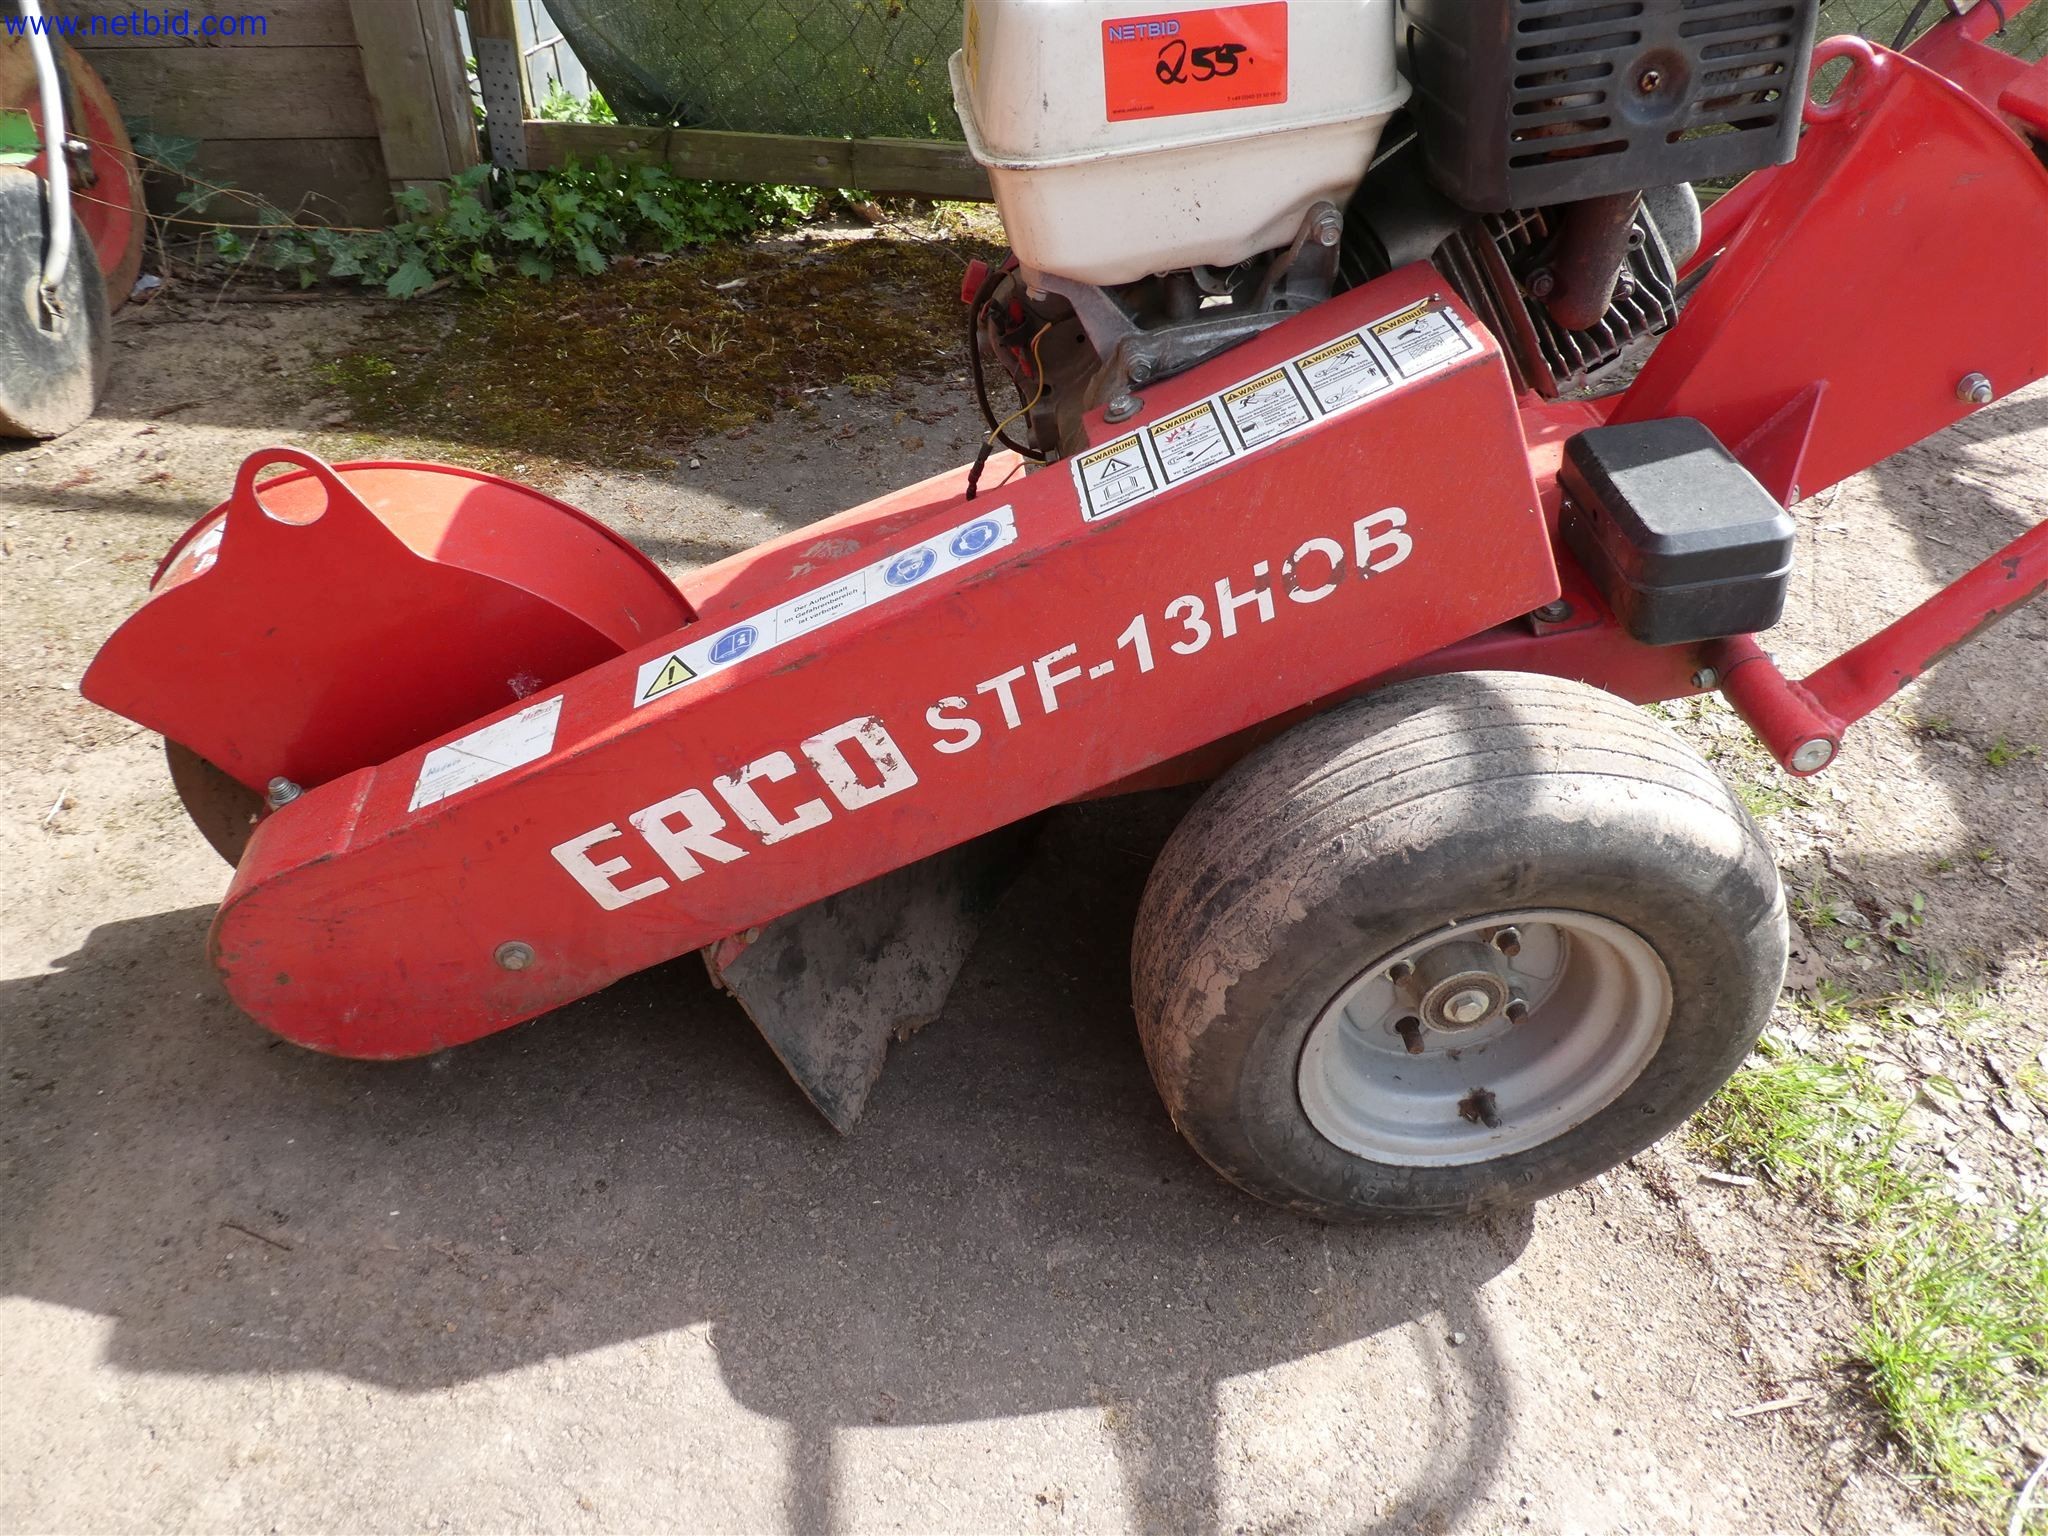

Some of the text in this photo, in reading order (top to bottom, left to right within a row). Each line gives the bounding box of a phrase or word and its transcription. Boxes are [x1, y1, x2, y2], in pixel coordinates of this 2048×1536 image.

[1109, 19, 1180, 41] NETBID
[1312, 338, 1359, 362] WARNUNG
[1237, 372, 1283, 396] WARNUNG
[1165, 406, 1210, 429] WARNUNG
[1094, 438, 1137, 461] WARNUNG
[784, 588, 858, 624] im Gefahrenbereich
[794, 585, 848, 613] Der Aufenthalt
[798, 602, 844, 625] ist verboten
[550, 505, 1413, 911] ERCO STF-13HOB
